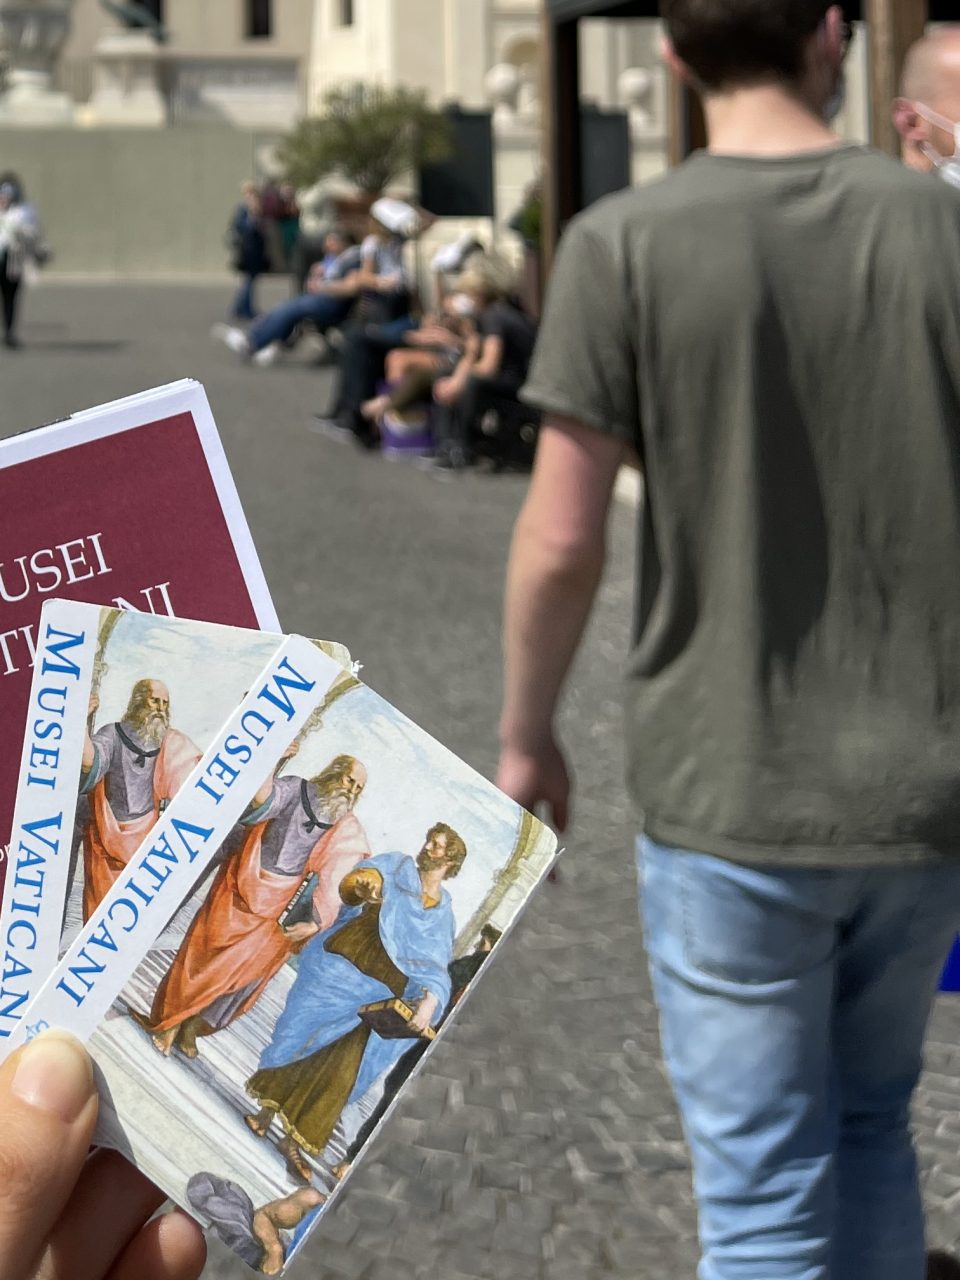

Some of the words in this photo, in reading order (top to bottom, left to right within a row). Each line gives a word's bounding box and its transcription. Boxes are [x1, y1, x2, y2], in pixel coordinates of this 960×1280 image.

[26, 623, 85, 790] MUSEI
[194, 656, 316, 805] MUSEI
[55, 818, 215, 1007] VATICANI
